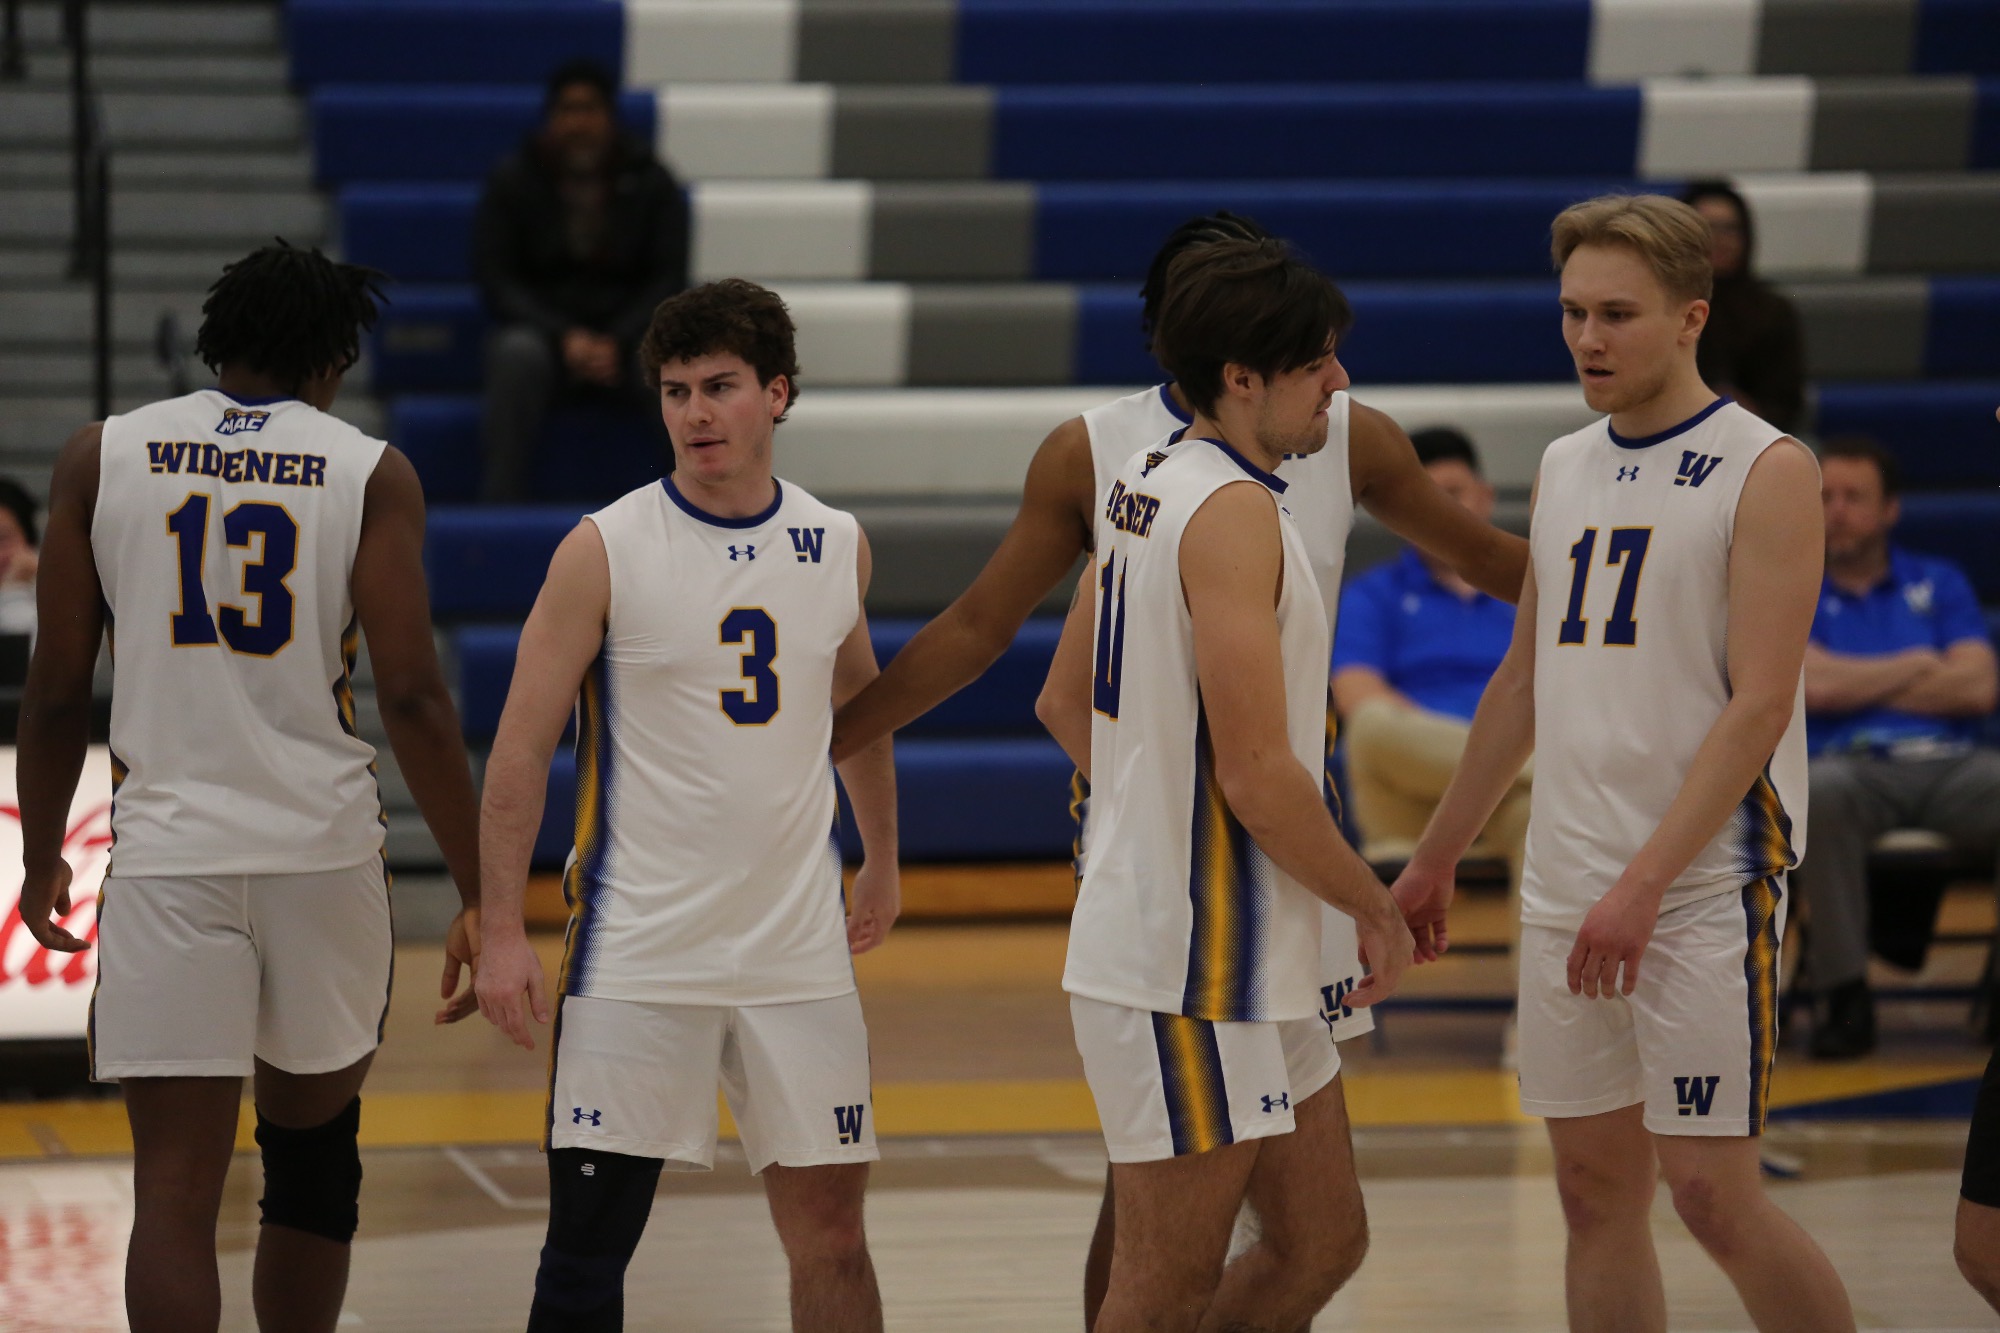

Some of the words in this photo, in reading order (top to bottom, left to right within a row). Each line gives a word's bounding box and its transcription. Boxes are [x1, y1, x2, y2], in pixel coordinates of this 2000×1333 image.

[218, 416, 264, 434] MAC
[147, 442, 327, 487] WIDENER
[1673, 450, 1724, 488] W
[787, 528, 825, 563] W
[166, 491, 300, 658] 13
[1557, 525, 1654, 648] 17
[718, 606, 781, 727] 3
[1320, 976, 1354, 1022] W
[1673, 1076, 1720, 1115] W
[834, 1104, 863, 1144] W
